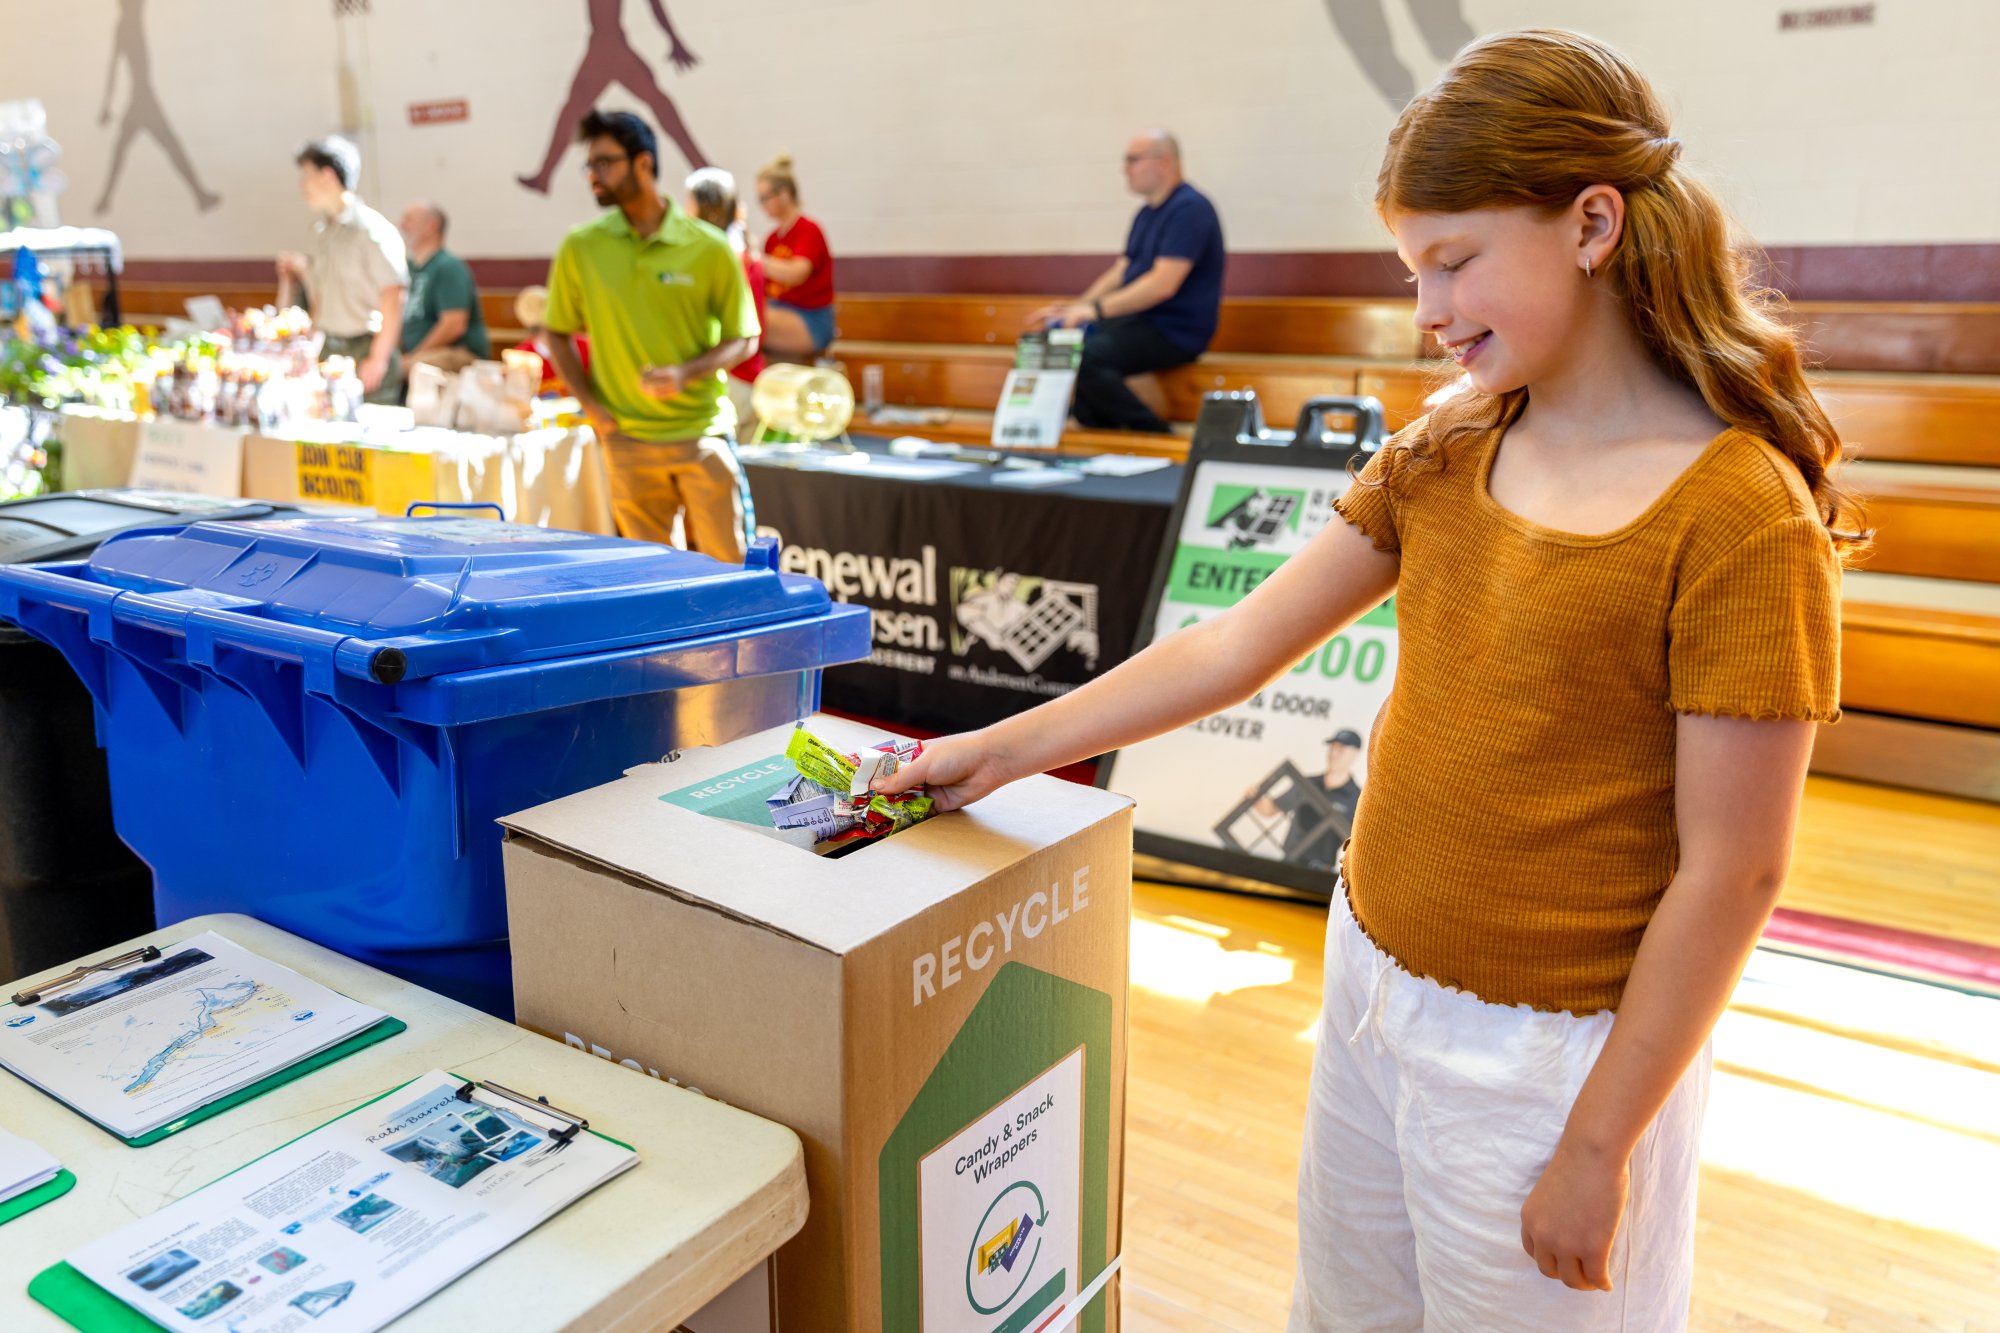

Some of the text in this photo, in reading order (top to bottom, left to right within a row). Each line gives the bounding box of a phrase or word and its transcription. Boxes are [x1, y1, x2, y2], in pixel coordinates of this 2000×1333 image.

[1272, 690, 1331, 719] DOOR
[689, 763, 785, 799] RECYCLE
[912, 865, 1089, 1008] RECYCLE
[366, 1122, 407, 1144] Rain
[955, 1093, 1054, 1176] Candy & Snack
[973, 1128, 1038, 1184] Wrappers
